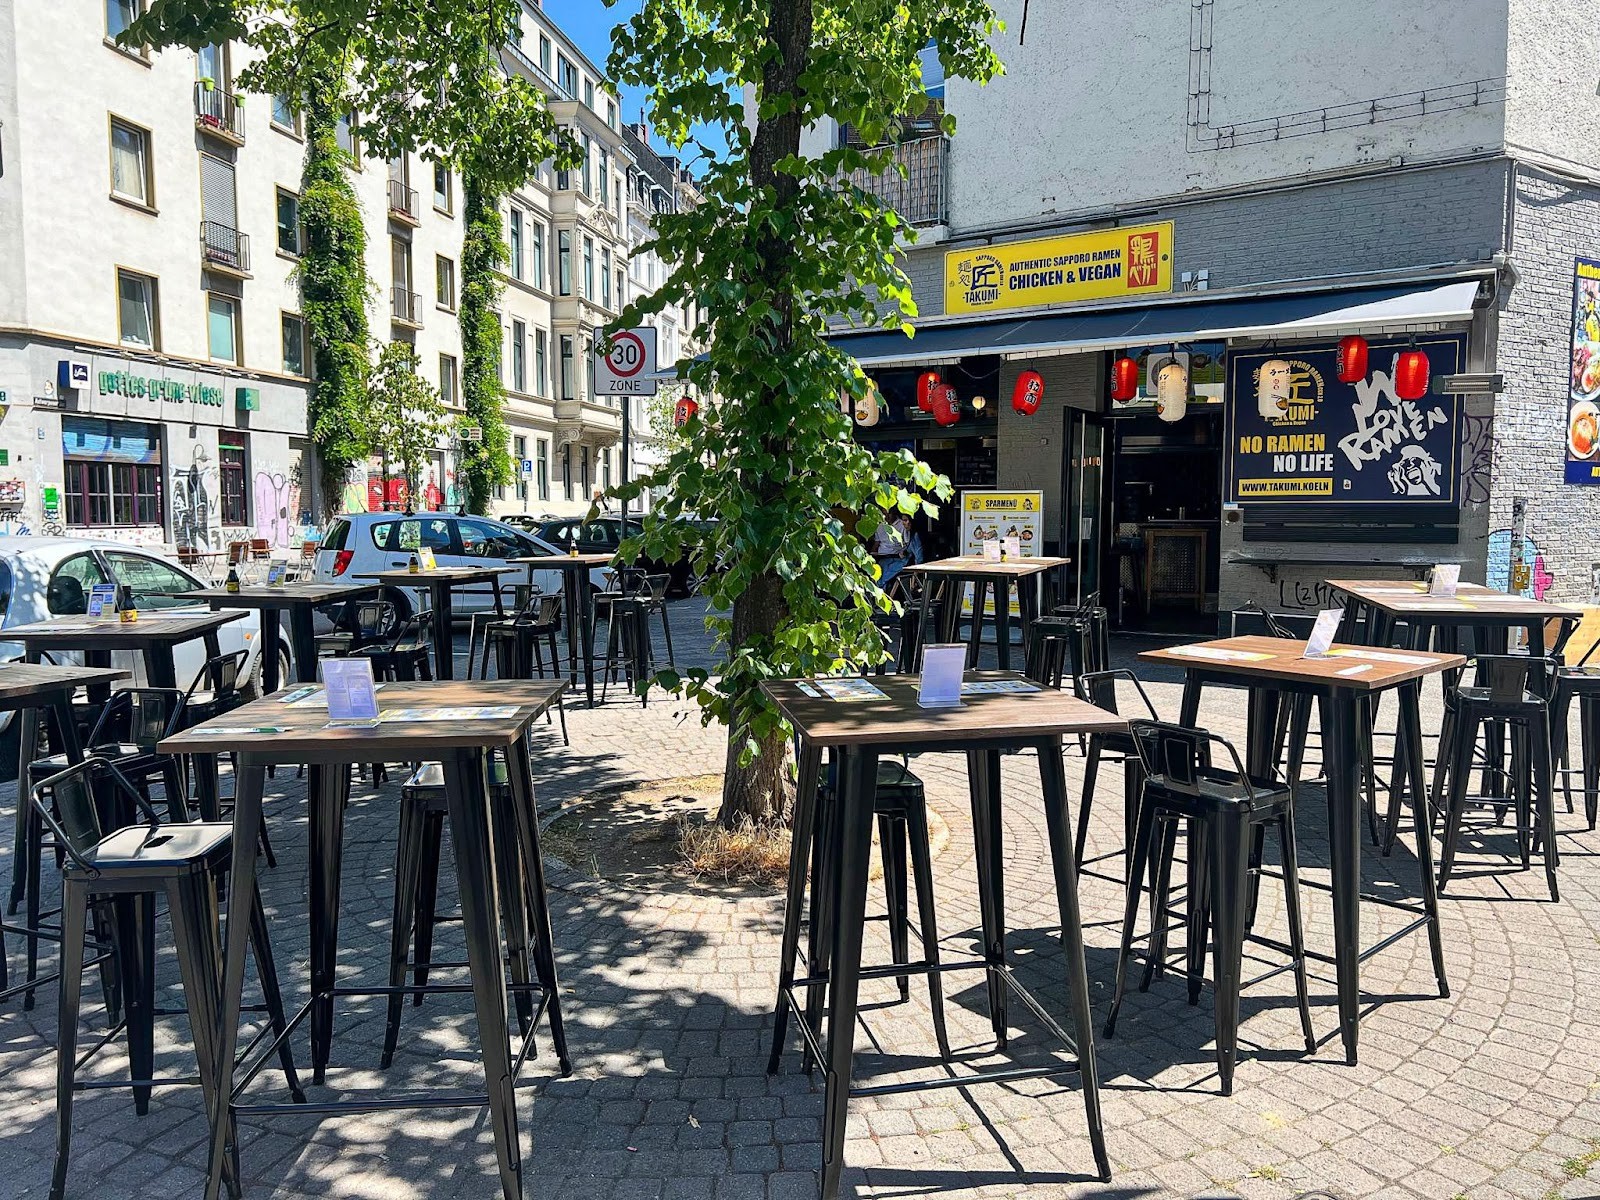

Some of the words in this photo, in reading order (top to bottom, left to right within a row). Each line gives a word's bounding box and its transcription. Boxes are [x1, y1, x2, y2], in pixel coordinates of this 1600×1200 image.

[1009, 258, 1052, 272] AUTHENTIC
[1053, 253, 1091, 267] SAPPORO
[1092, 249, 1121, 262] RAMEN
[1009, 270, 1063, 290] CHICKEN
[1066, 270, 1076, 283] &
[1078, 262, 1121, 282] VEGAN
[613, 344, 637, 365] 30
[98, 370, 147, 396] gottes
[188, 382, 223, 405] wiese
[609, 380, 641, 391] ZONE
[1240, 436, 1263, 454] NO
[1266, 433, 1326, 453] RAMEN
[1338, 406, 1448, 471] RAMEN
[1273, 454, 1297, 472] NO
[1300, 453, 1334, 471] LIFE
[1241, 481, 1330, 492] WWW.TAKUMI.KOELN
[985, 498, 1018, 508] SPARMENÜ
